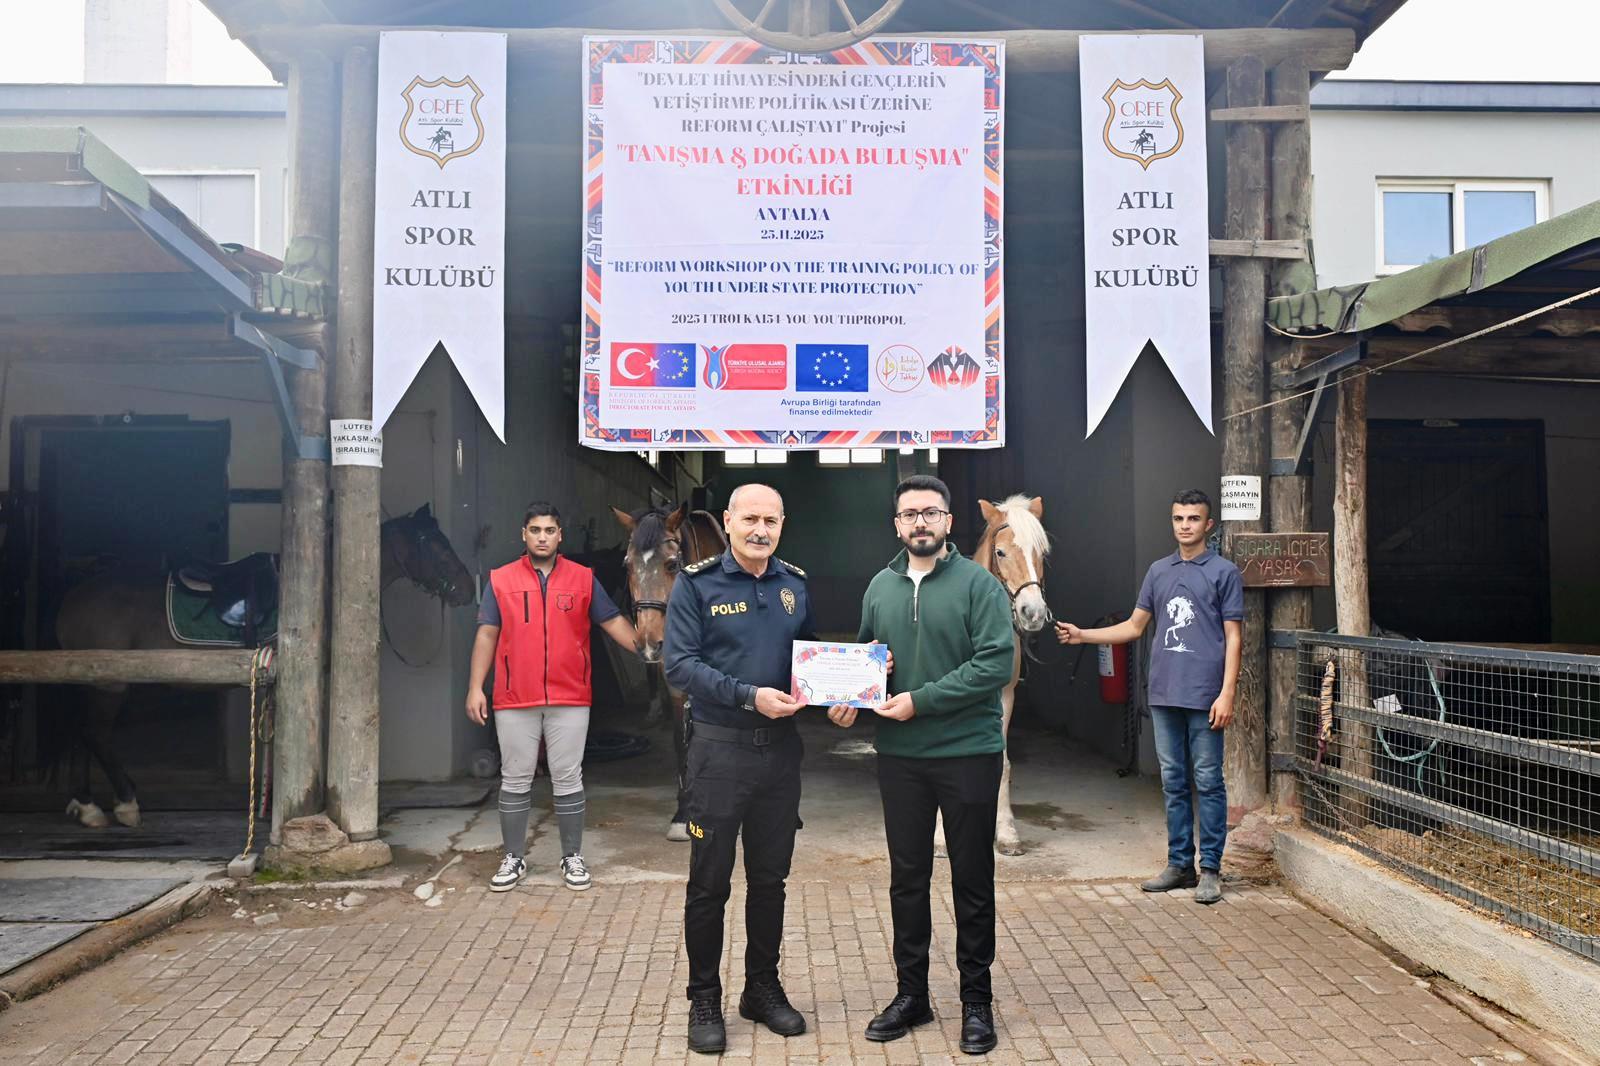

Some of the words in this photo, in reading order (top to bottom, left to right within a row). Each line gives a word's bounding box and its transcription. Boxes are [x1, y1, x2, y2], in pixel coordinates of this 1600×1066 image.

[637, 71, 711, 87] "DEVLET
[713, 69, 848, 88] HİMAYESİNDEKİ
[850, 71, 947, 91] GENÇLERİN
[419, 98, 464, 114] ORFE
[652, 92, 756, 113] YETİŞTİRME
[759, 92, 857, 111] POLİTİKASI
[859, 93, 932, 111] ÜZERİNE
[1120, 100, 1164, 117] ORFE
[681, 119, 753, 133] REFORM
[756, 119, 848, 137] ÇALIŞTAYI"
[851, 120, 906, 138] Projesi
[616, 143, 725, 168] "TANIŞMA
[730, 146, 748, 170] &
[753, 143, 851, 165] DOĞADA
[855, 147, 969, 171] BULUŞMA"
[737, 173, 853, 197] ETKİNLİĞİ
[410, 189, 472, 209] ATLI
[1116, 191, 1174, 210] ATLI
[755, 207, 831, 222] ANTALYA
[404, 226, 476, 247] SPOR
[1112, 227, 1179, 247] SPOR
[384, 264, 495, 288] KULÜBÜ
[679, 260, 769, 274] WORKSHOP
[769, 261, 792, 274] ON
[793, 261, 826, 274] THE
[827, 261, 900, 275] TRAINING
[903, 262, 956, 276] POLICY
[958, 262, 980, 276] OF
[1094, 264, 1199, 288] KULÜBÜ
[664, 281, 715, 294] YOUTH
[717, 281, 769, 294] UNDER
[771, 281, 818, 294] STATE
[671, 313, 701, 324] 2025
[785, 313, 810, 325] YOU
[780, 398, 811, 410] Avrupa
[812, 398, 838, 410] Birliği
[838, 398, 881, 408] tarafından
[789, 406, 820, 416] finanse
[821, 406, 873, 416] edilmektedir
[1257, 559, 1303, 577] YASAK
